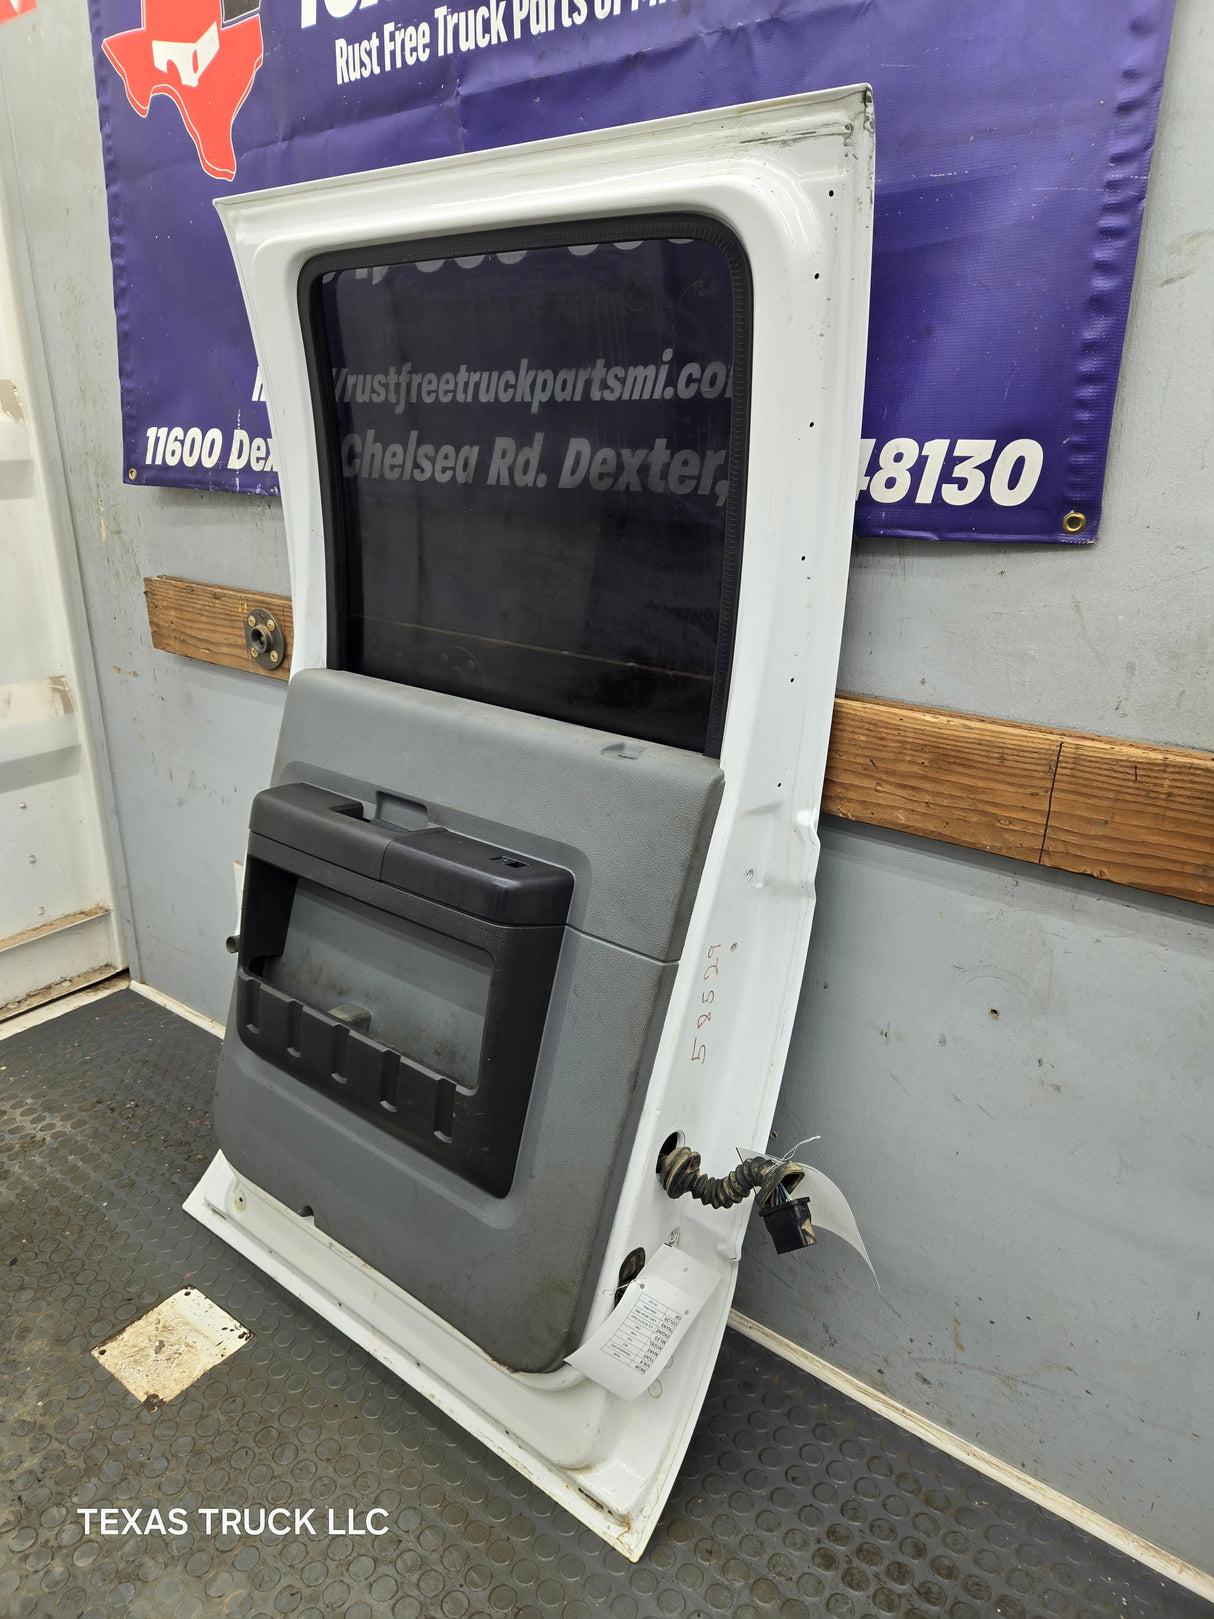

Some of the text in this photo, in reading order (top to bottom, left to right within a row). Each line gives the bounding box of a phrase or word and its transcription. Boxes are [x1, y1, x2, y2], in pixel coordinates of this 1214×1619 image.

[335, 38, 381, 85] Rust
[383, 21, 430, 72] Free
[434, 0, 508, 57] Truck
[512, 0, 588, 40] Parts
[145, 426, 223, 468] 11600
[341, 429, 480, 484] Chelsea
[486, 432, 548, 488] Rd.
[558, 438, 729, 507] Dexter,
